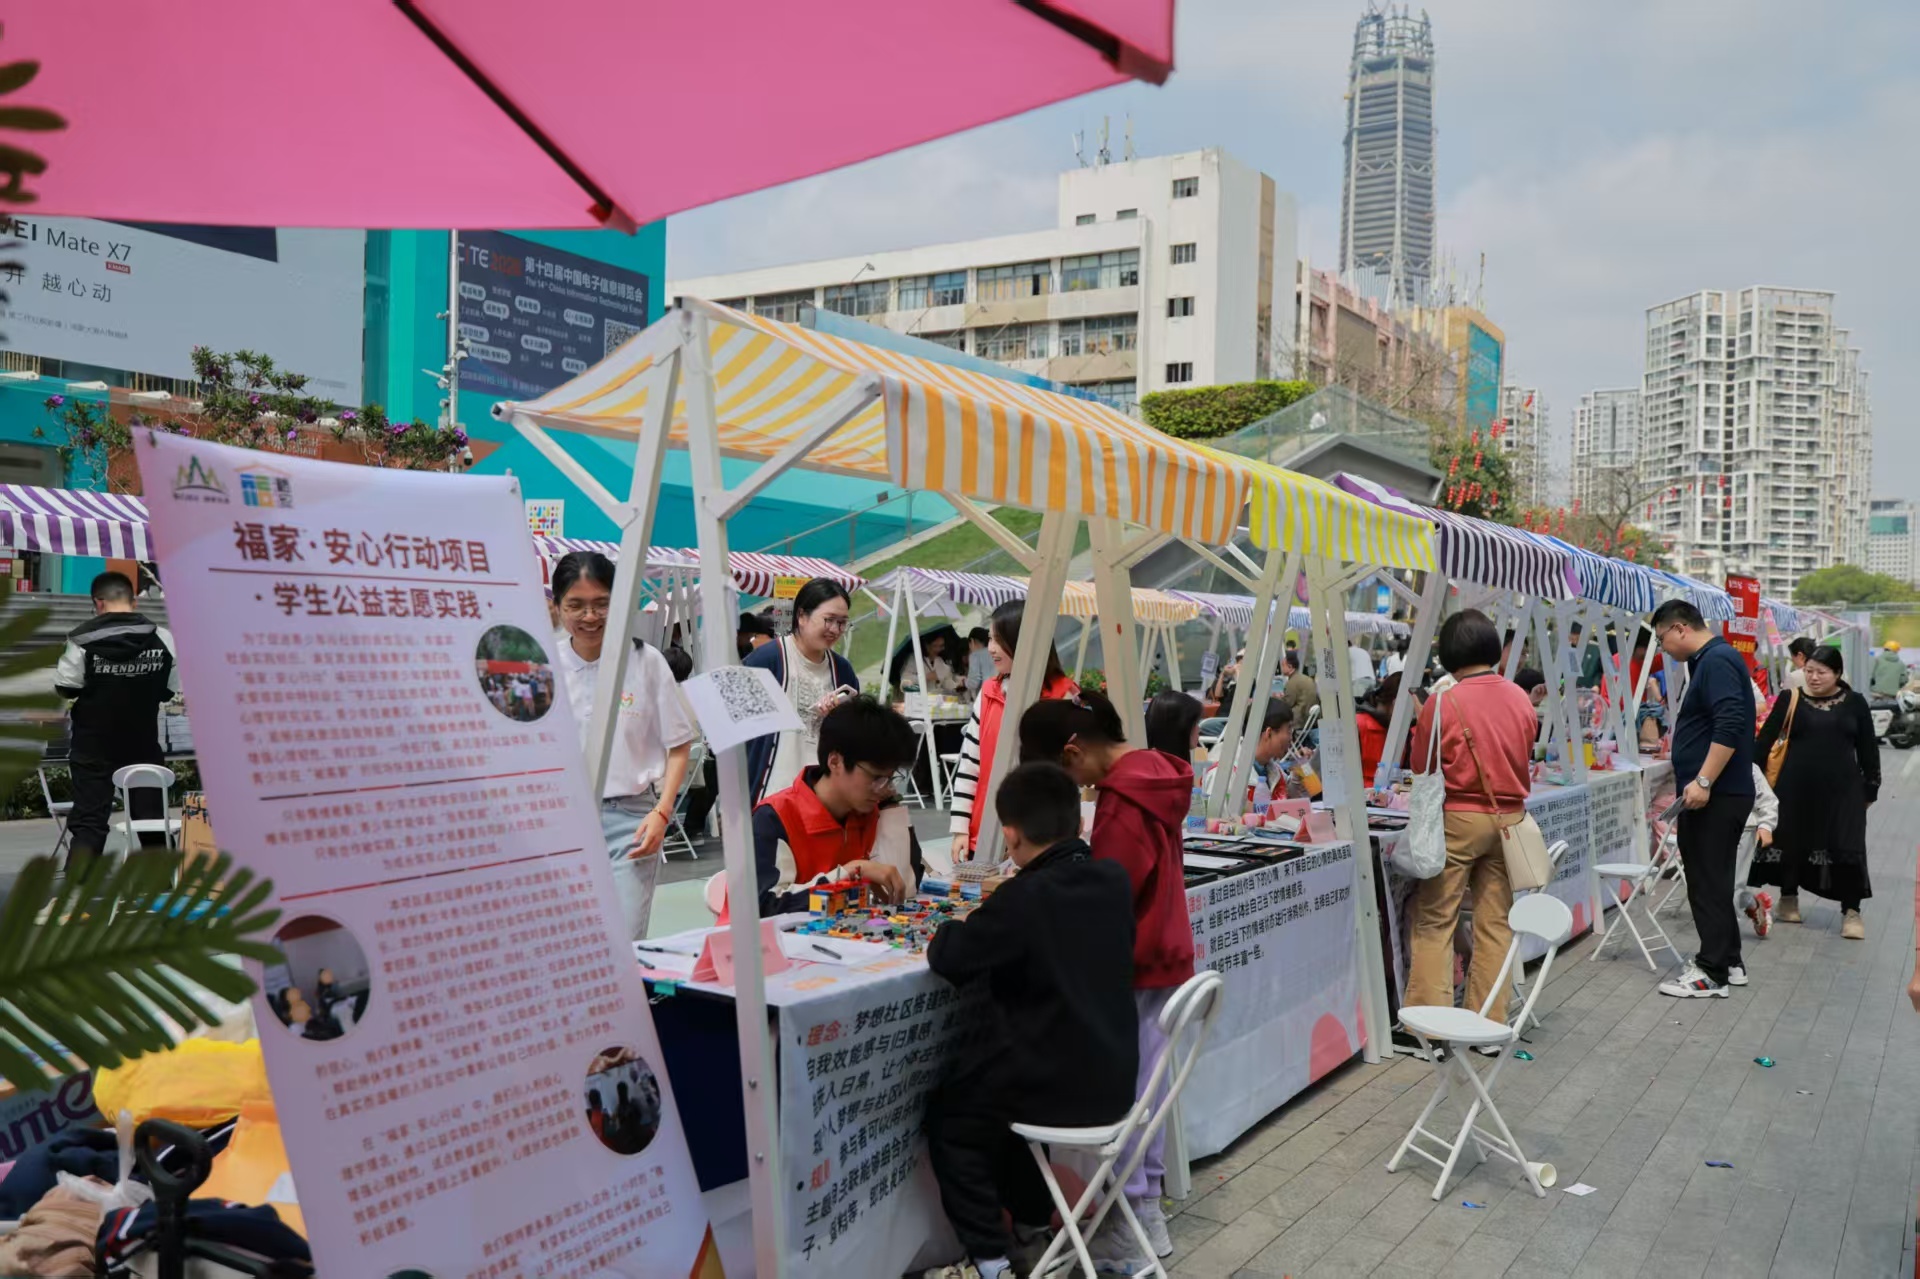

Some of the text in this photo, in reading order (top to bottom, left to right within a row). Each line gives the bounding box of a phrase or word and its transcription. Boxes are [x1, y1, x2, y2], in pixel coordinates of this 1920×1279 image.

[47, 227, 100, 256] Mate
[107, 241, 132, 261] X7
[42, 271, 112, 303] 越心动
[232, 521, 491, 574] 福家·安心行动项目
